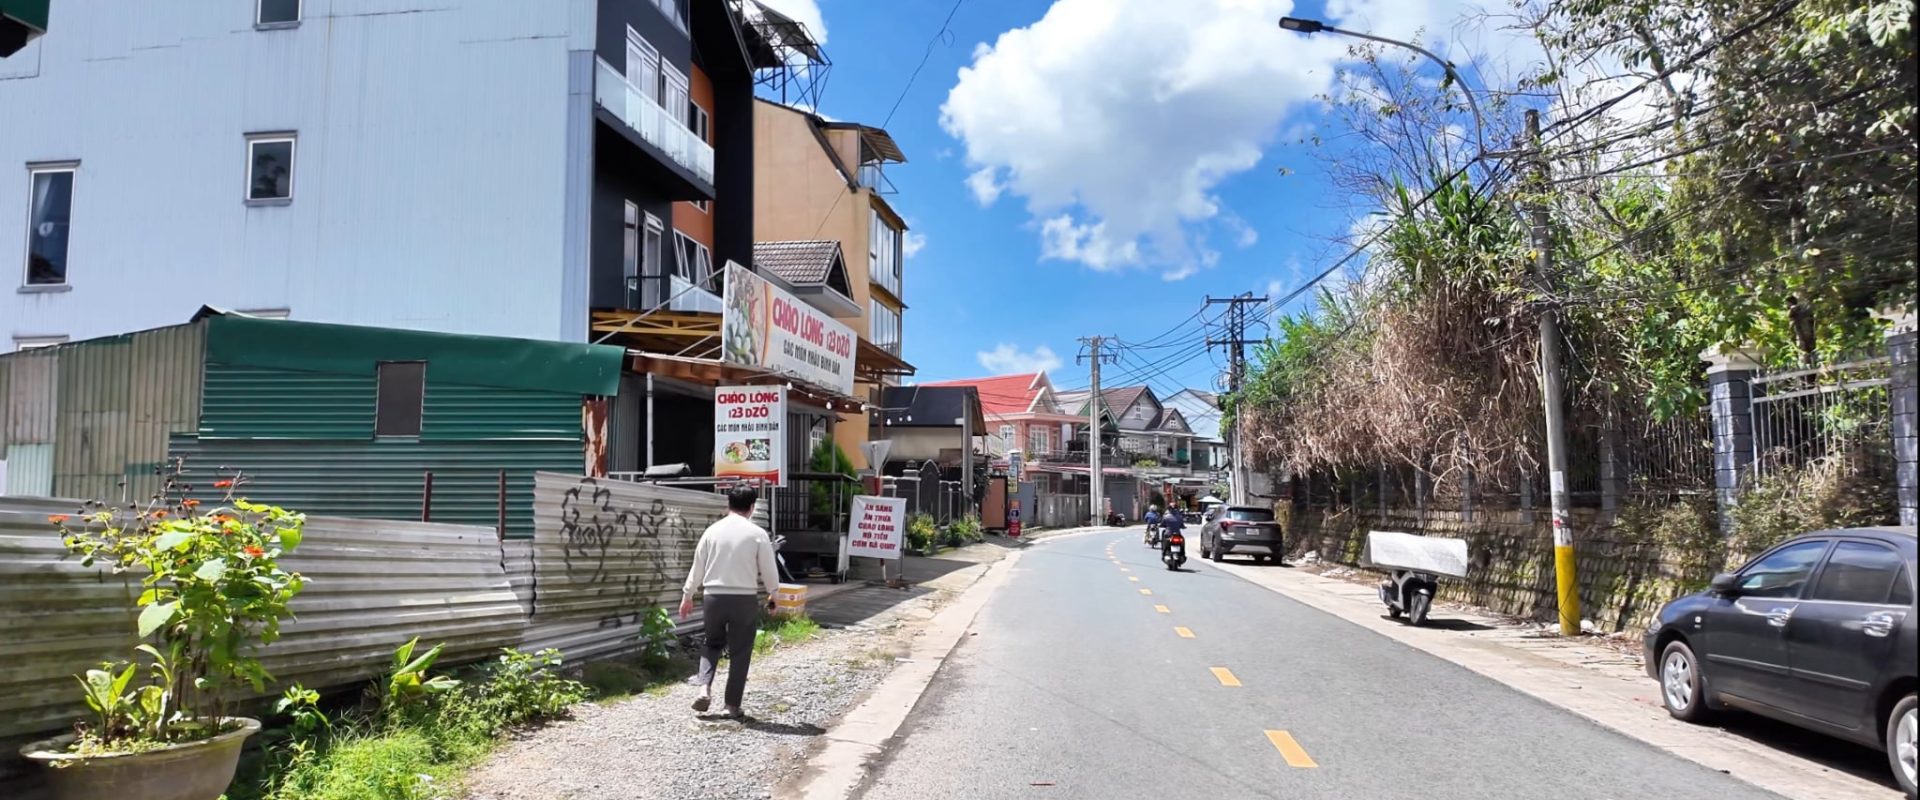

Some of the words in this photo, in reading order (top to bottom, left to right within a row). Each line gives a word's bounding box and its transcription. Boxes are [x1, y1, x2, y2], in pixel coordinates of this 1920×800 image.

[772, 297, 799, 336] CHÁO
[800, 309, 824, 347] LÒNG
[827, 331, 836, 352] 123
[836, 333, 850, 359] DZÔ
[717, 391, 746, 404] CHÁO
[750, 390, 779, 403] LÒNG
[728, 407, 743, 418] 123
[745, 404, 769, 418] DZÔ
